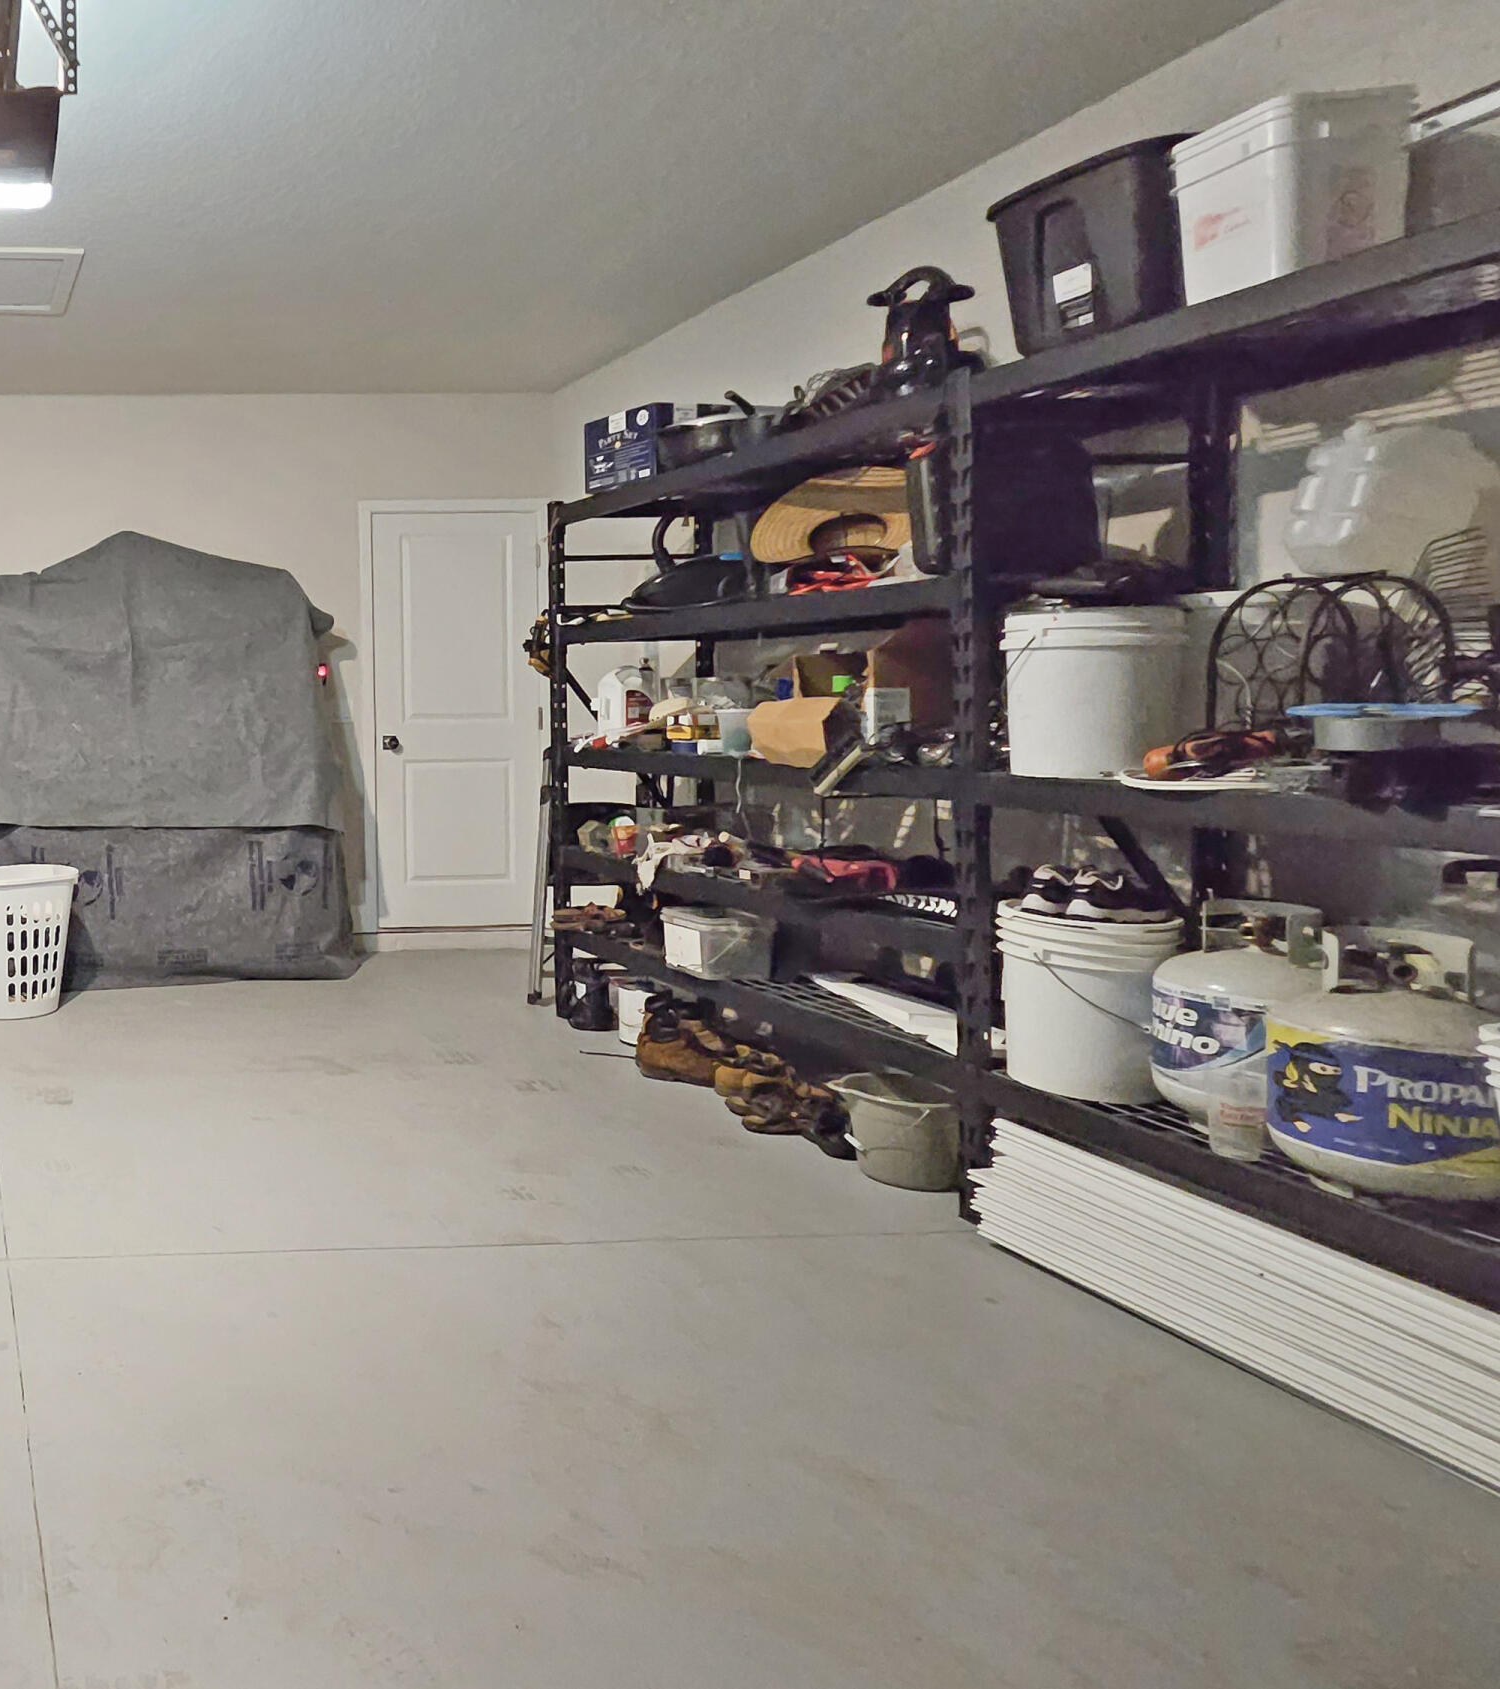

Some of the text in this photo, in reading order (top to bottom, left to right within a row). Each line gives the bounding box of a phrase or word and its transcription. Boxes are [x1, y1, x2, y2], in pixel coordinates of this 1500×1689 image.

[1151, 994, 1199, 1027] lue
[1151, 1016, 1221, 1055] hino
[1388, 1102, 1499, 1139] NINJA
